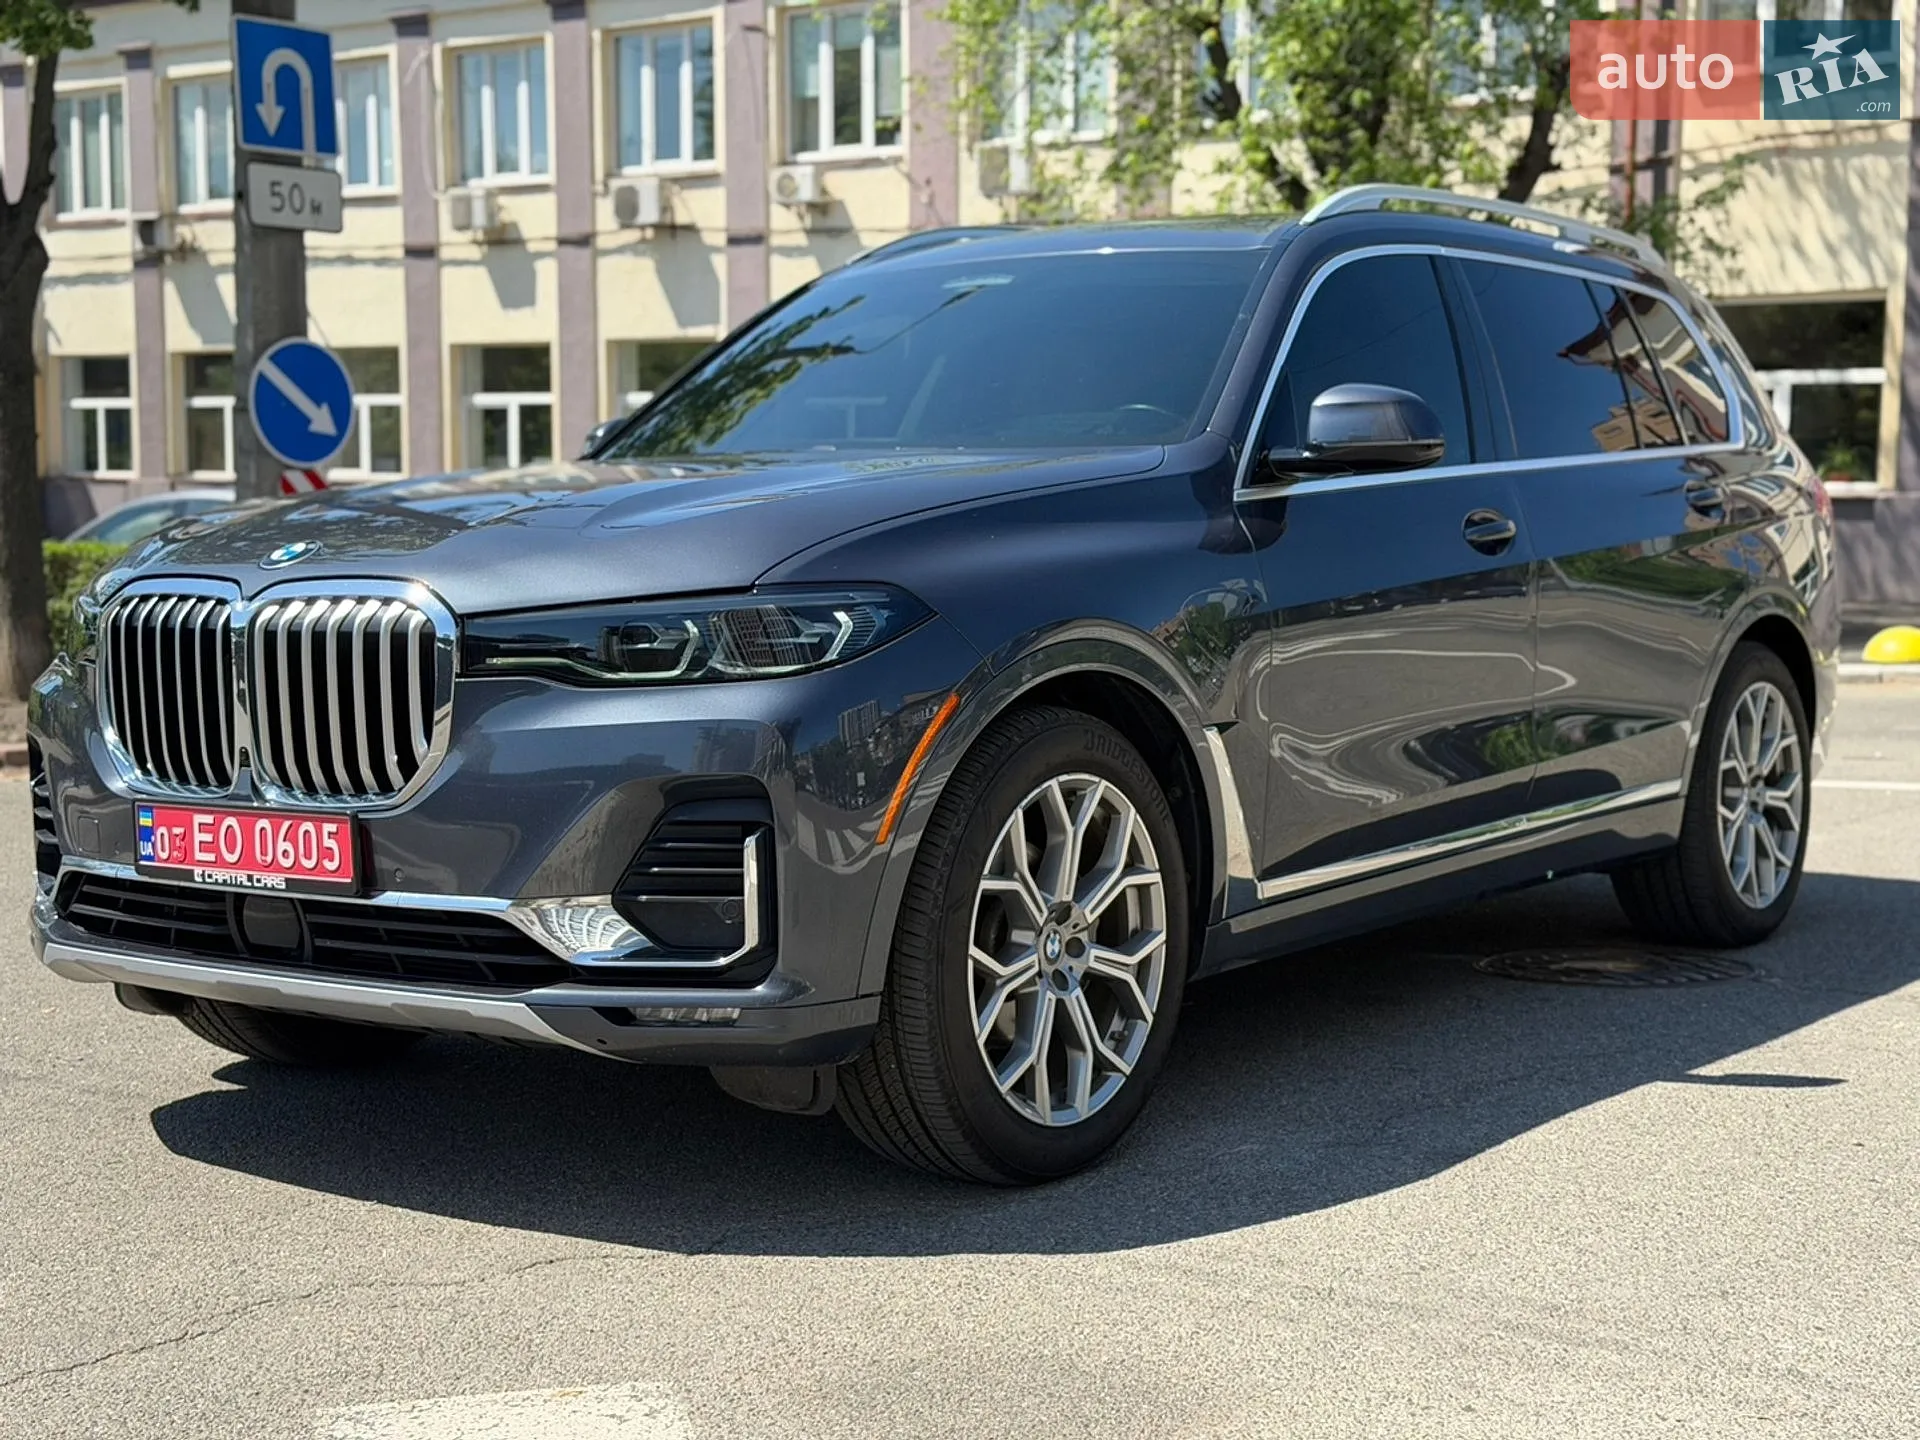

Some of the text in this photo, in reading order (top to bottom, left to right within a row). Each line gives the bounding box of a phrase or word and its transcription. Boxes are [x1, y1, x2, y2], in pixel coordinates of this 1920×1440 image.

[270, 181, 305, 214] 50
[140, 841, 153, 856] UA
[255, 819, 340, 871] 0605
[205, 872, 286, 890] CAPITAL CARS
